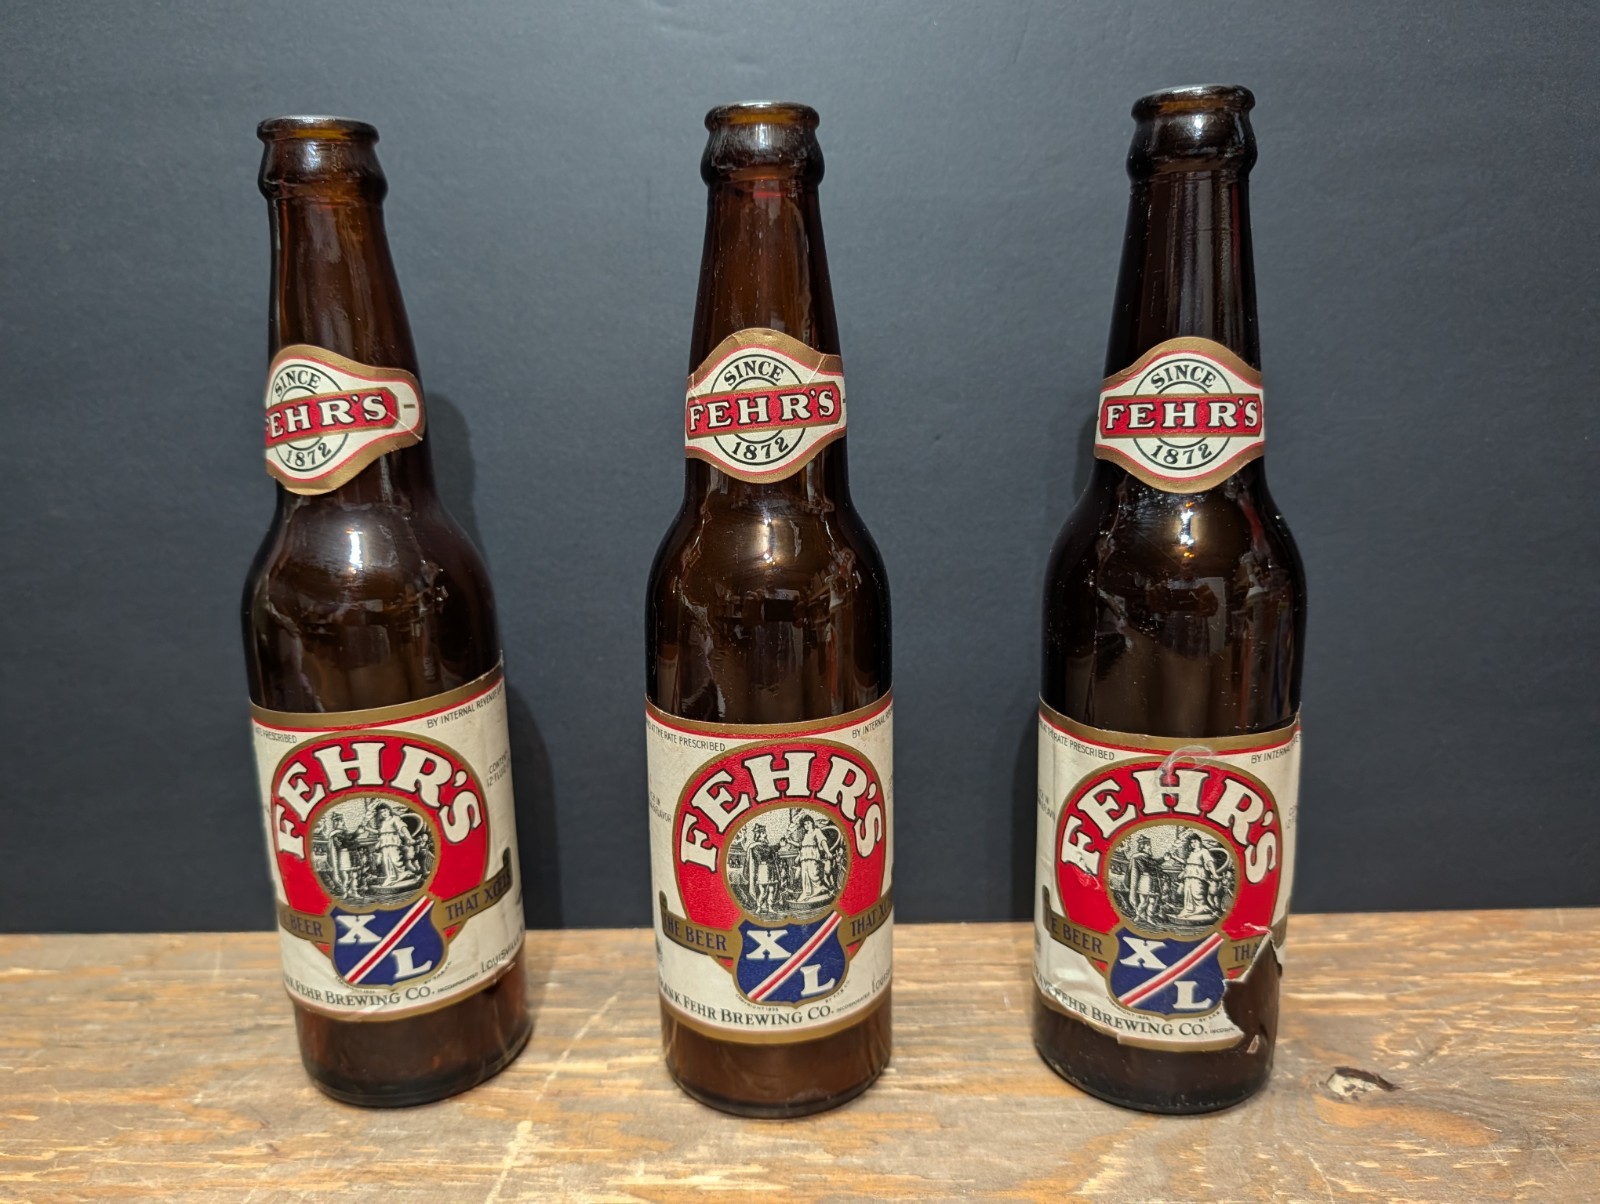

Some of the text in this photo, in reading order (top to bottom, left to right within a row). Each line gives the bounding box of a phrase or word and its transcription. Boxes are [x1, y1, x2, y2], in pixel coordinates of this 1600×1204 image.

[274, 370, 321, 397] SINCE
[723, 360, 784, 386] SINCE
[1150, 364, 1216, 389] SINCE
[265, 394, 388, 439] EHR'S
[689, 388, 836, 432] FEHR'S
[1105, 397, 1259, 430] FEHR'S
[286, 442, 331, 467] 1872
[731, 436, 789, 460] 1872
[1151, 443, 1213, 465] 1872
[427, 717, 438, 729] BY
[440, 703, 476, 725] INTERNAL
[679, 735, 726, 752] PRESCRIBED
[852, 728, 862, 739] BY
[1069, 739, 1115, 761] PRESCRIBED
[1251, 753, 1263, 764] BY
[274, 741, 482, 860] FEHR'S
[680, 750, 884, 874] FEHR'S
[1060, 767, 1278, 885] FEHR'S
[446, 893, 481, 920] THAT
[290, 913, 323, 937] BEER
[685, 925, 727, 951] BEER
[850, 912, 877, 937] THAT
[336, 914, 383, 944] X
[391, 946, 433, 981] L
[1062, 923, 1103, 955] BEER
[746, 929, 792, 960] X
[800, 964, 836, 997] L
[1119, 935, 1212, 1009] X L
[296, 980, 324, 1002] FEHR
[325, 990, 401, 1007] BREWING
[405, 985, 435, 1001] CO.
[683, 994, 717, 1020] FEHR
[719, 1007, 803, 1026] BREWING
[807, 1004, 835, 1020] CO.
[1054, 988, 1088, 1016] FEHR
[1090, 1006, 1174, 1036] BREWING
[1178, 1022, 1208, 1037] CO.
